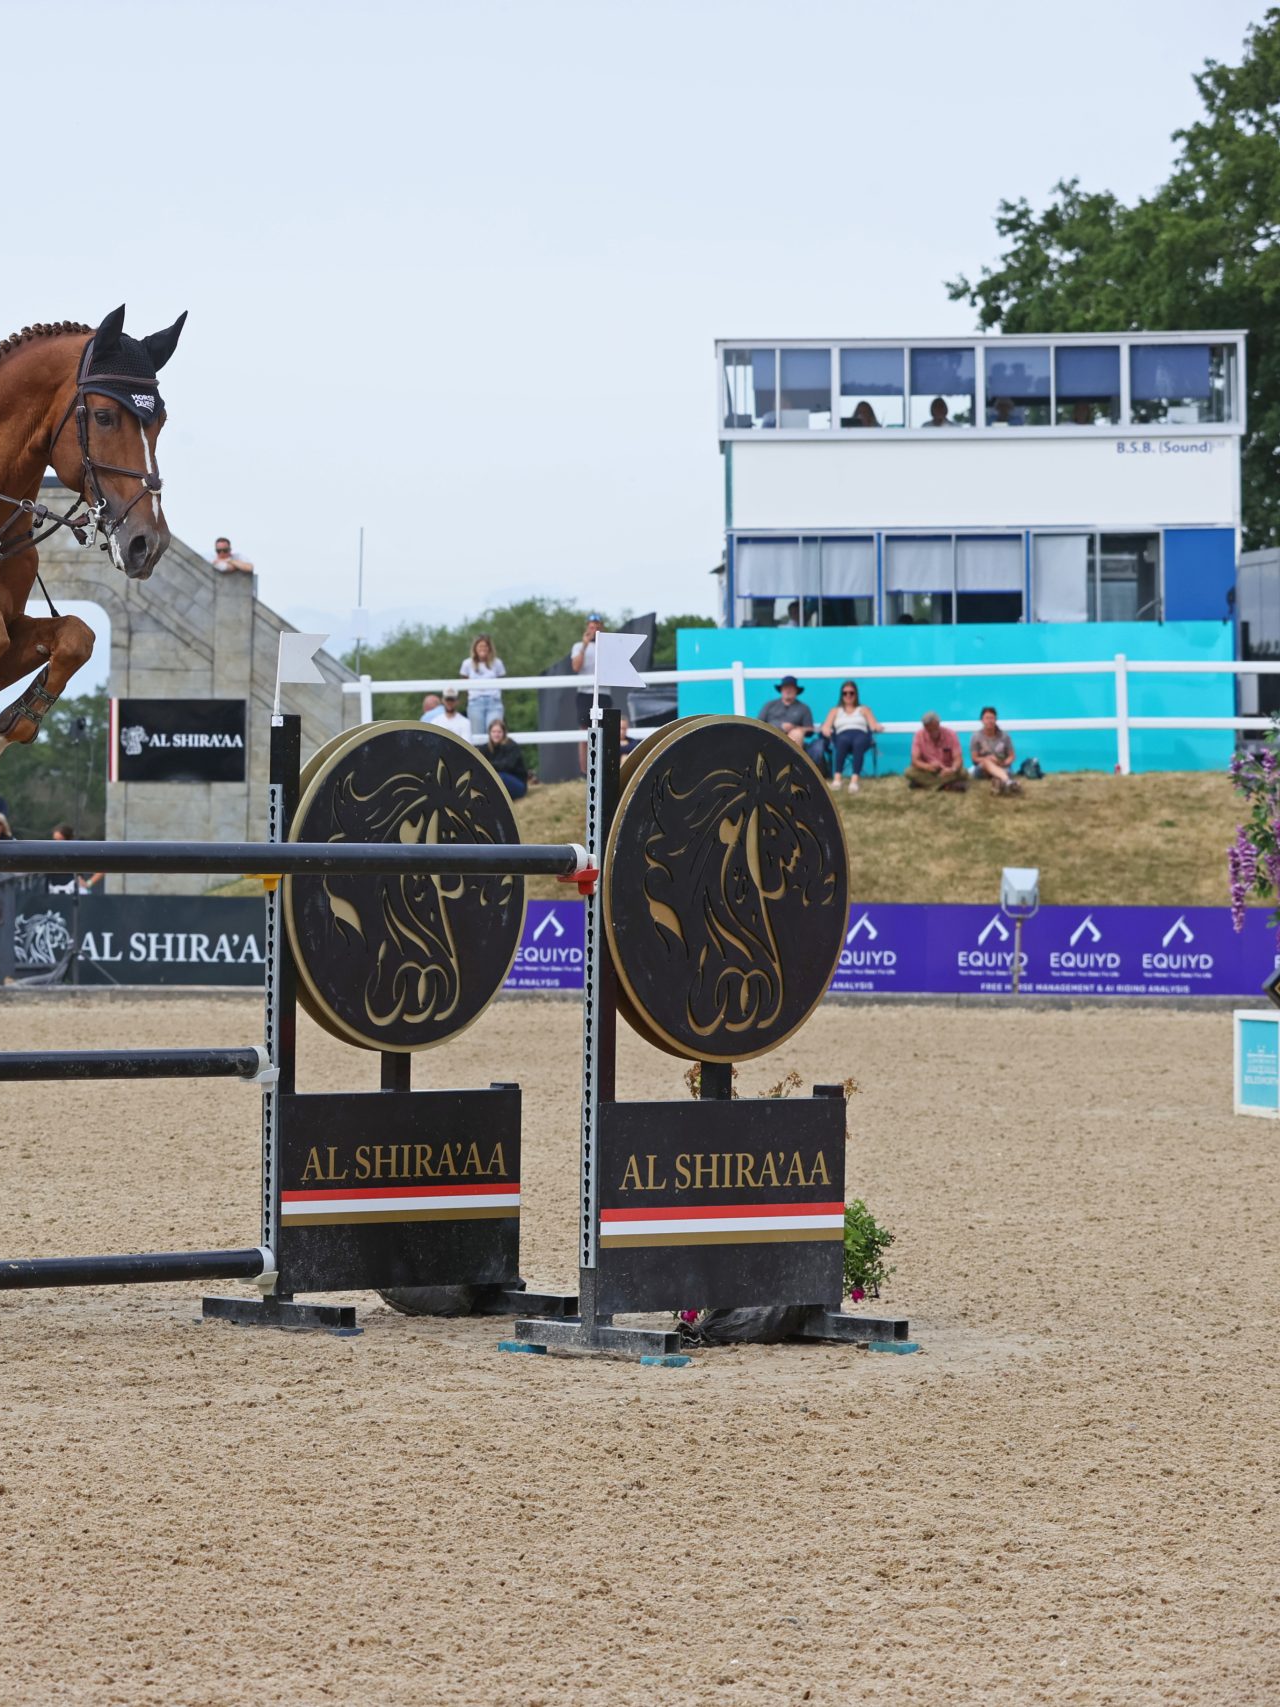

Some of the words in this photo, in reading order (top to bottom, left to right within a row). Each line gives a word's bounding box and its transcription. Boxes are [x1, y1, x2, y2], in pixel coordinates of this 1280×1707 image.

[1159, 440, 1213, 453] (Sound)
[148, 733, 171, 748] AL
[172, 733, 243, 748] SHIRA'AA
[78, 931, 123, 961] AL
[129, 931, 266, 963] SHIRA'A
[838, 950, 897, 966] QUIYD
[1049, 952, 1121, 969] EQUIYD
[1141, 953, 1214, 970] EQUIYD
[1004, 983, 1034, 992] HRSE
[1035, 983, 1095, 993] MANAGEMENT
[1147, 984, 1191, 994] ANALYSIS
[300, 1146, 349, 1181] AL
[354, 1142, 509, 1180] SHIRA'AA
[618, 1153, 667, 1190] AL
[675, 1150, 831, 1190] SHIRA'AA
